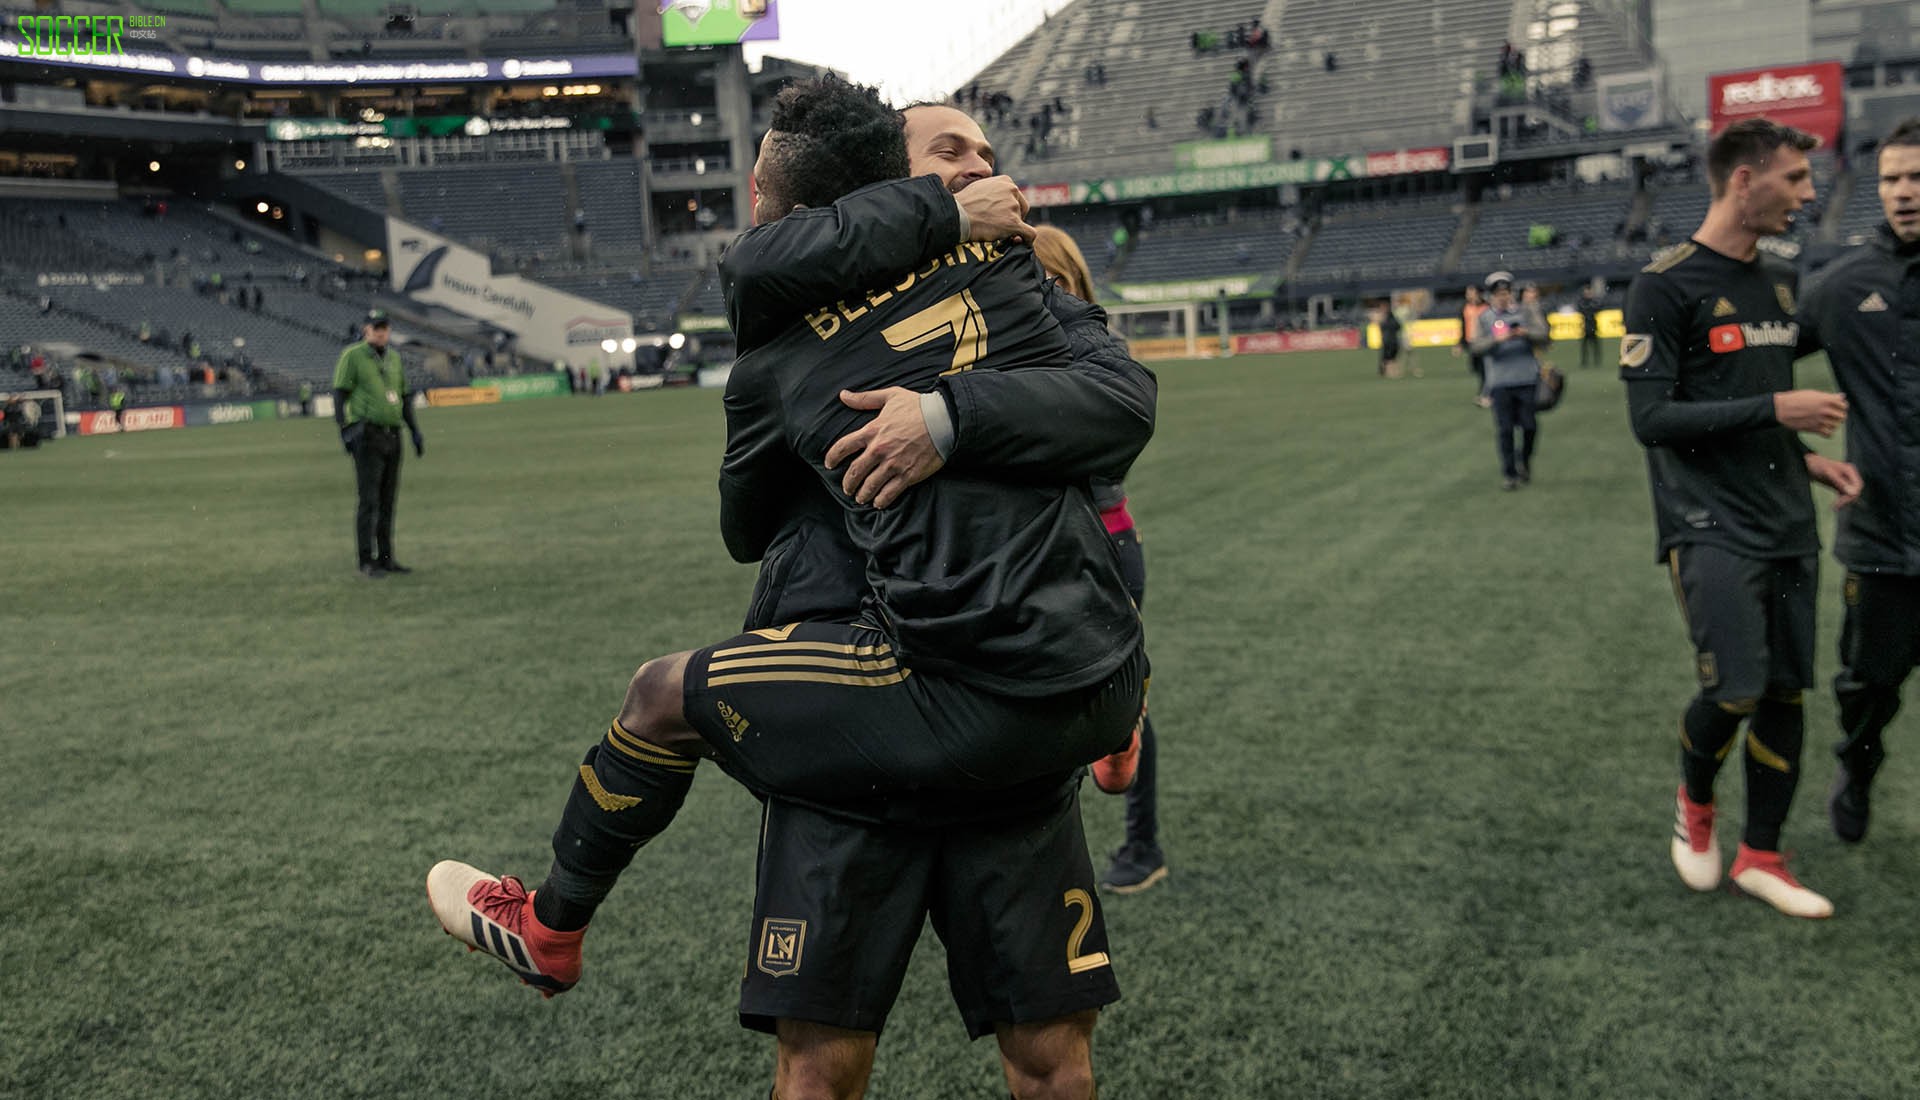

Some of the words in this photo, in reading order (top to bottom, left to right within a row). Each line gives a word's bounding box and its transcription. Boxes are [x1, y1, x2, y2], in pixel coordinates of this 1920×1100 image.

[443, 272, 478, 297] Insure
[483, 285, 536, 320] Carefully
[880, 288, 988, 376] 7
[1740, 320, 1799, 347] YouTube
[717, 700, 743, 742] adidas
[1063, 888, 1110, 975] 2
